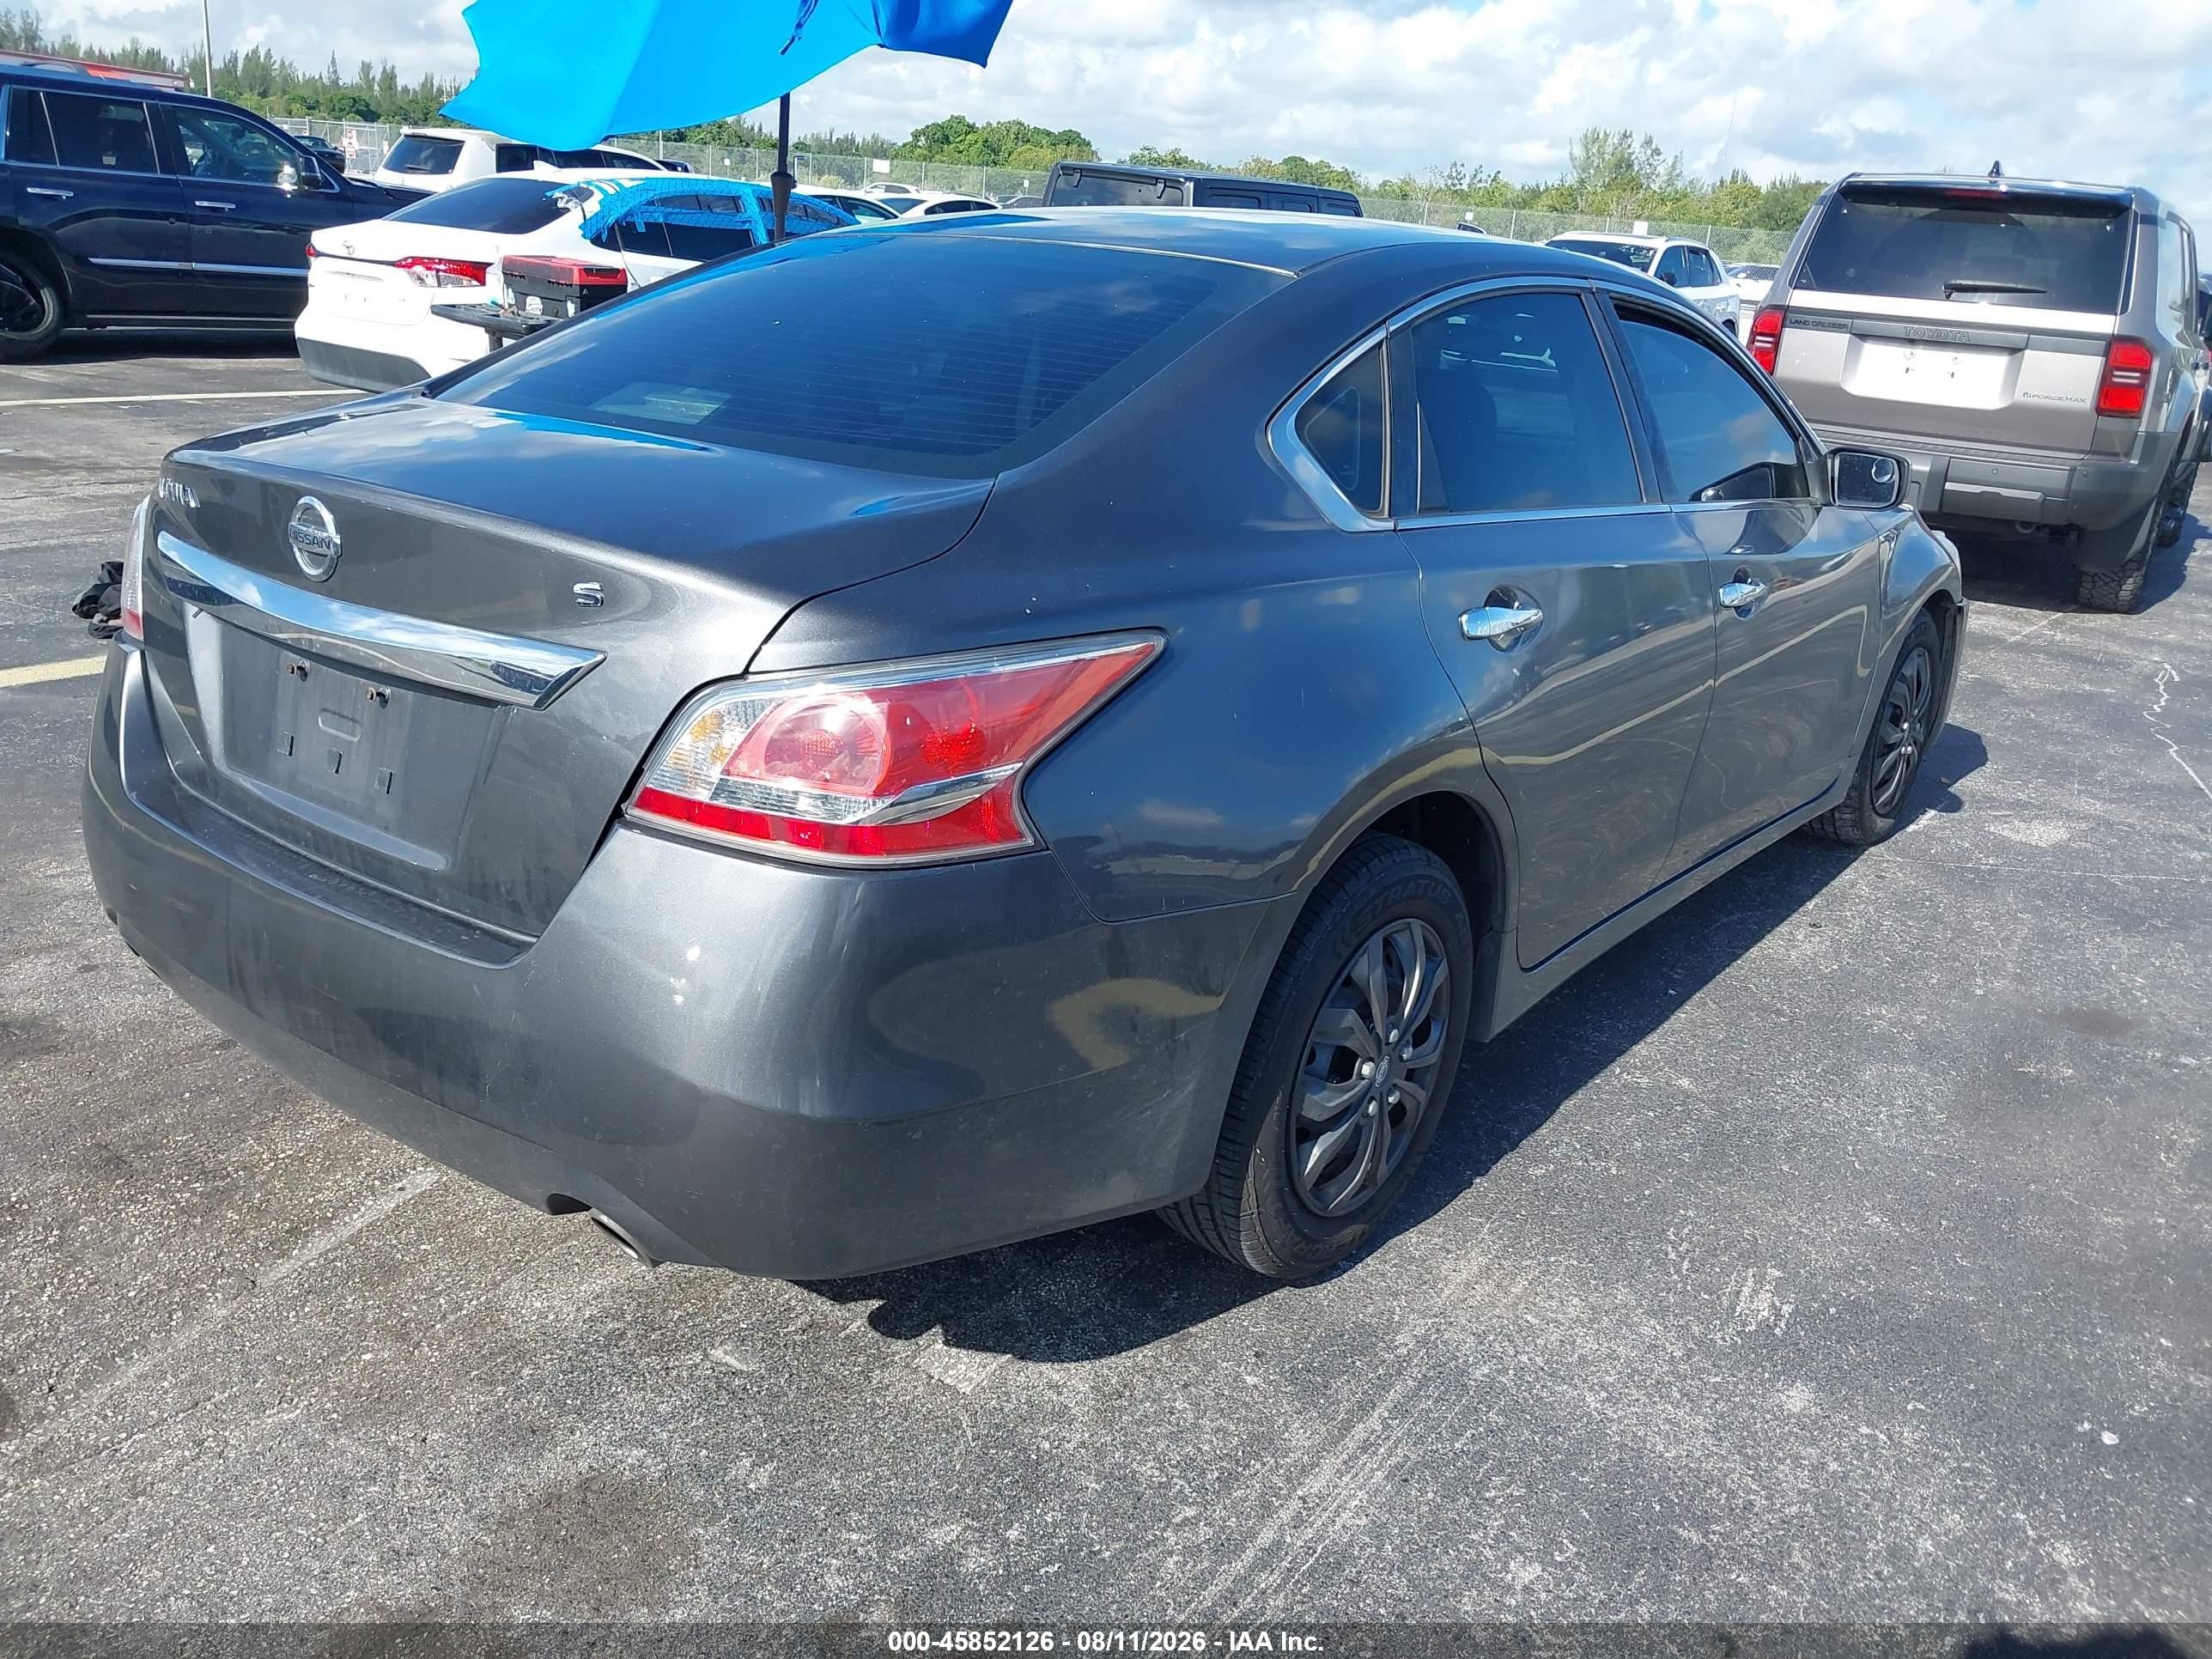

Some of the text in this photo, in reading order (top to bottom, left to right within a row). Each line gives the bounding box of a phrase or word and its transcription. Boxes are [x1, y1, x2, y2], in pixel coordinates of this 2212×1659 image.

[1904, 325, 1972, 343] TOYOTA
[289, 526, 332, 550] NISSAN
[573, 581, 604, 608] S
